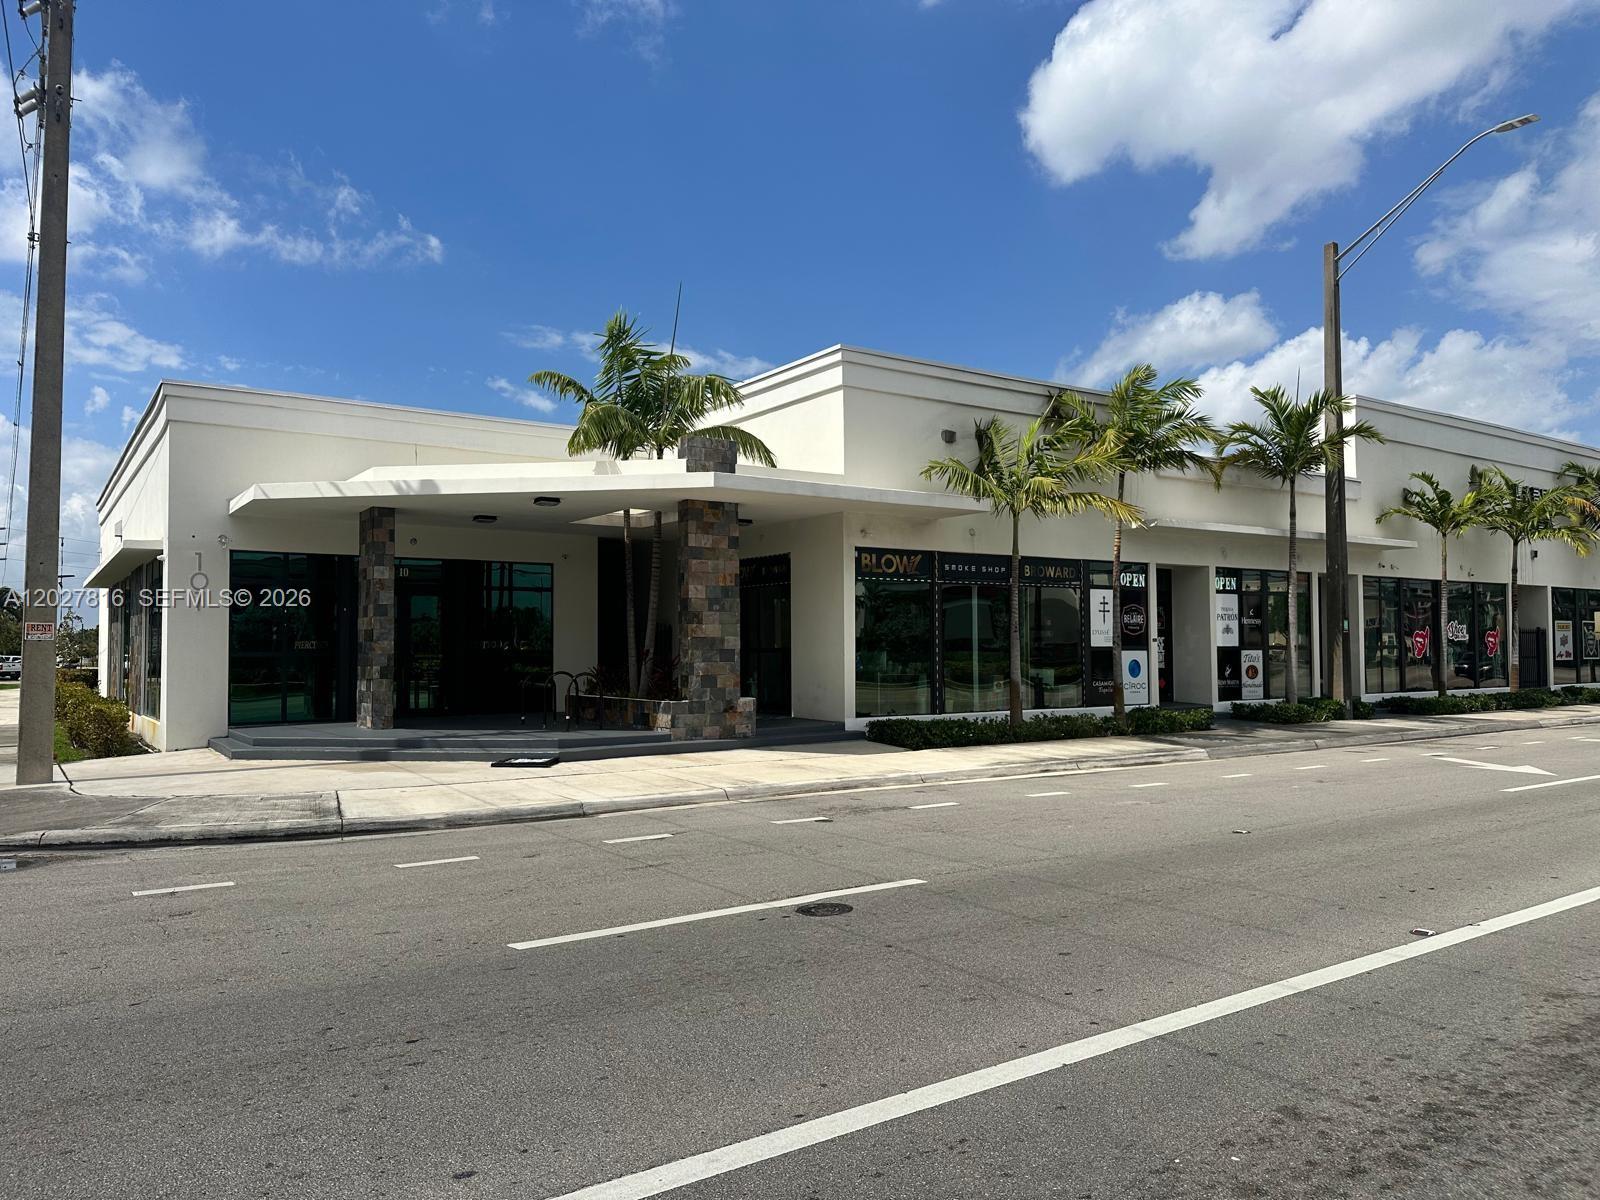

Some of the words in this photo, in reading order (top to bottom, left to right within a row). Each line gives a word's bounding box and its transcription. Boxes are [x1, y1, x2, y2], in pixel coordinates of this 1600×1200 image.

[944, 564, 976, 572] SMOKE
[981, 565, 1006, 573] SHOP
[1024, 564, 1076, 579] BROWARD
[1120, 572, 1146, 588] OPEN
[1215, 576, 1237, 590] OPEN
[31, 623, 53, 632] RENT
